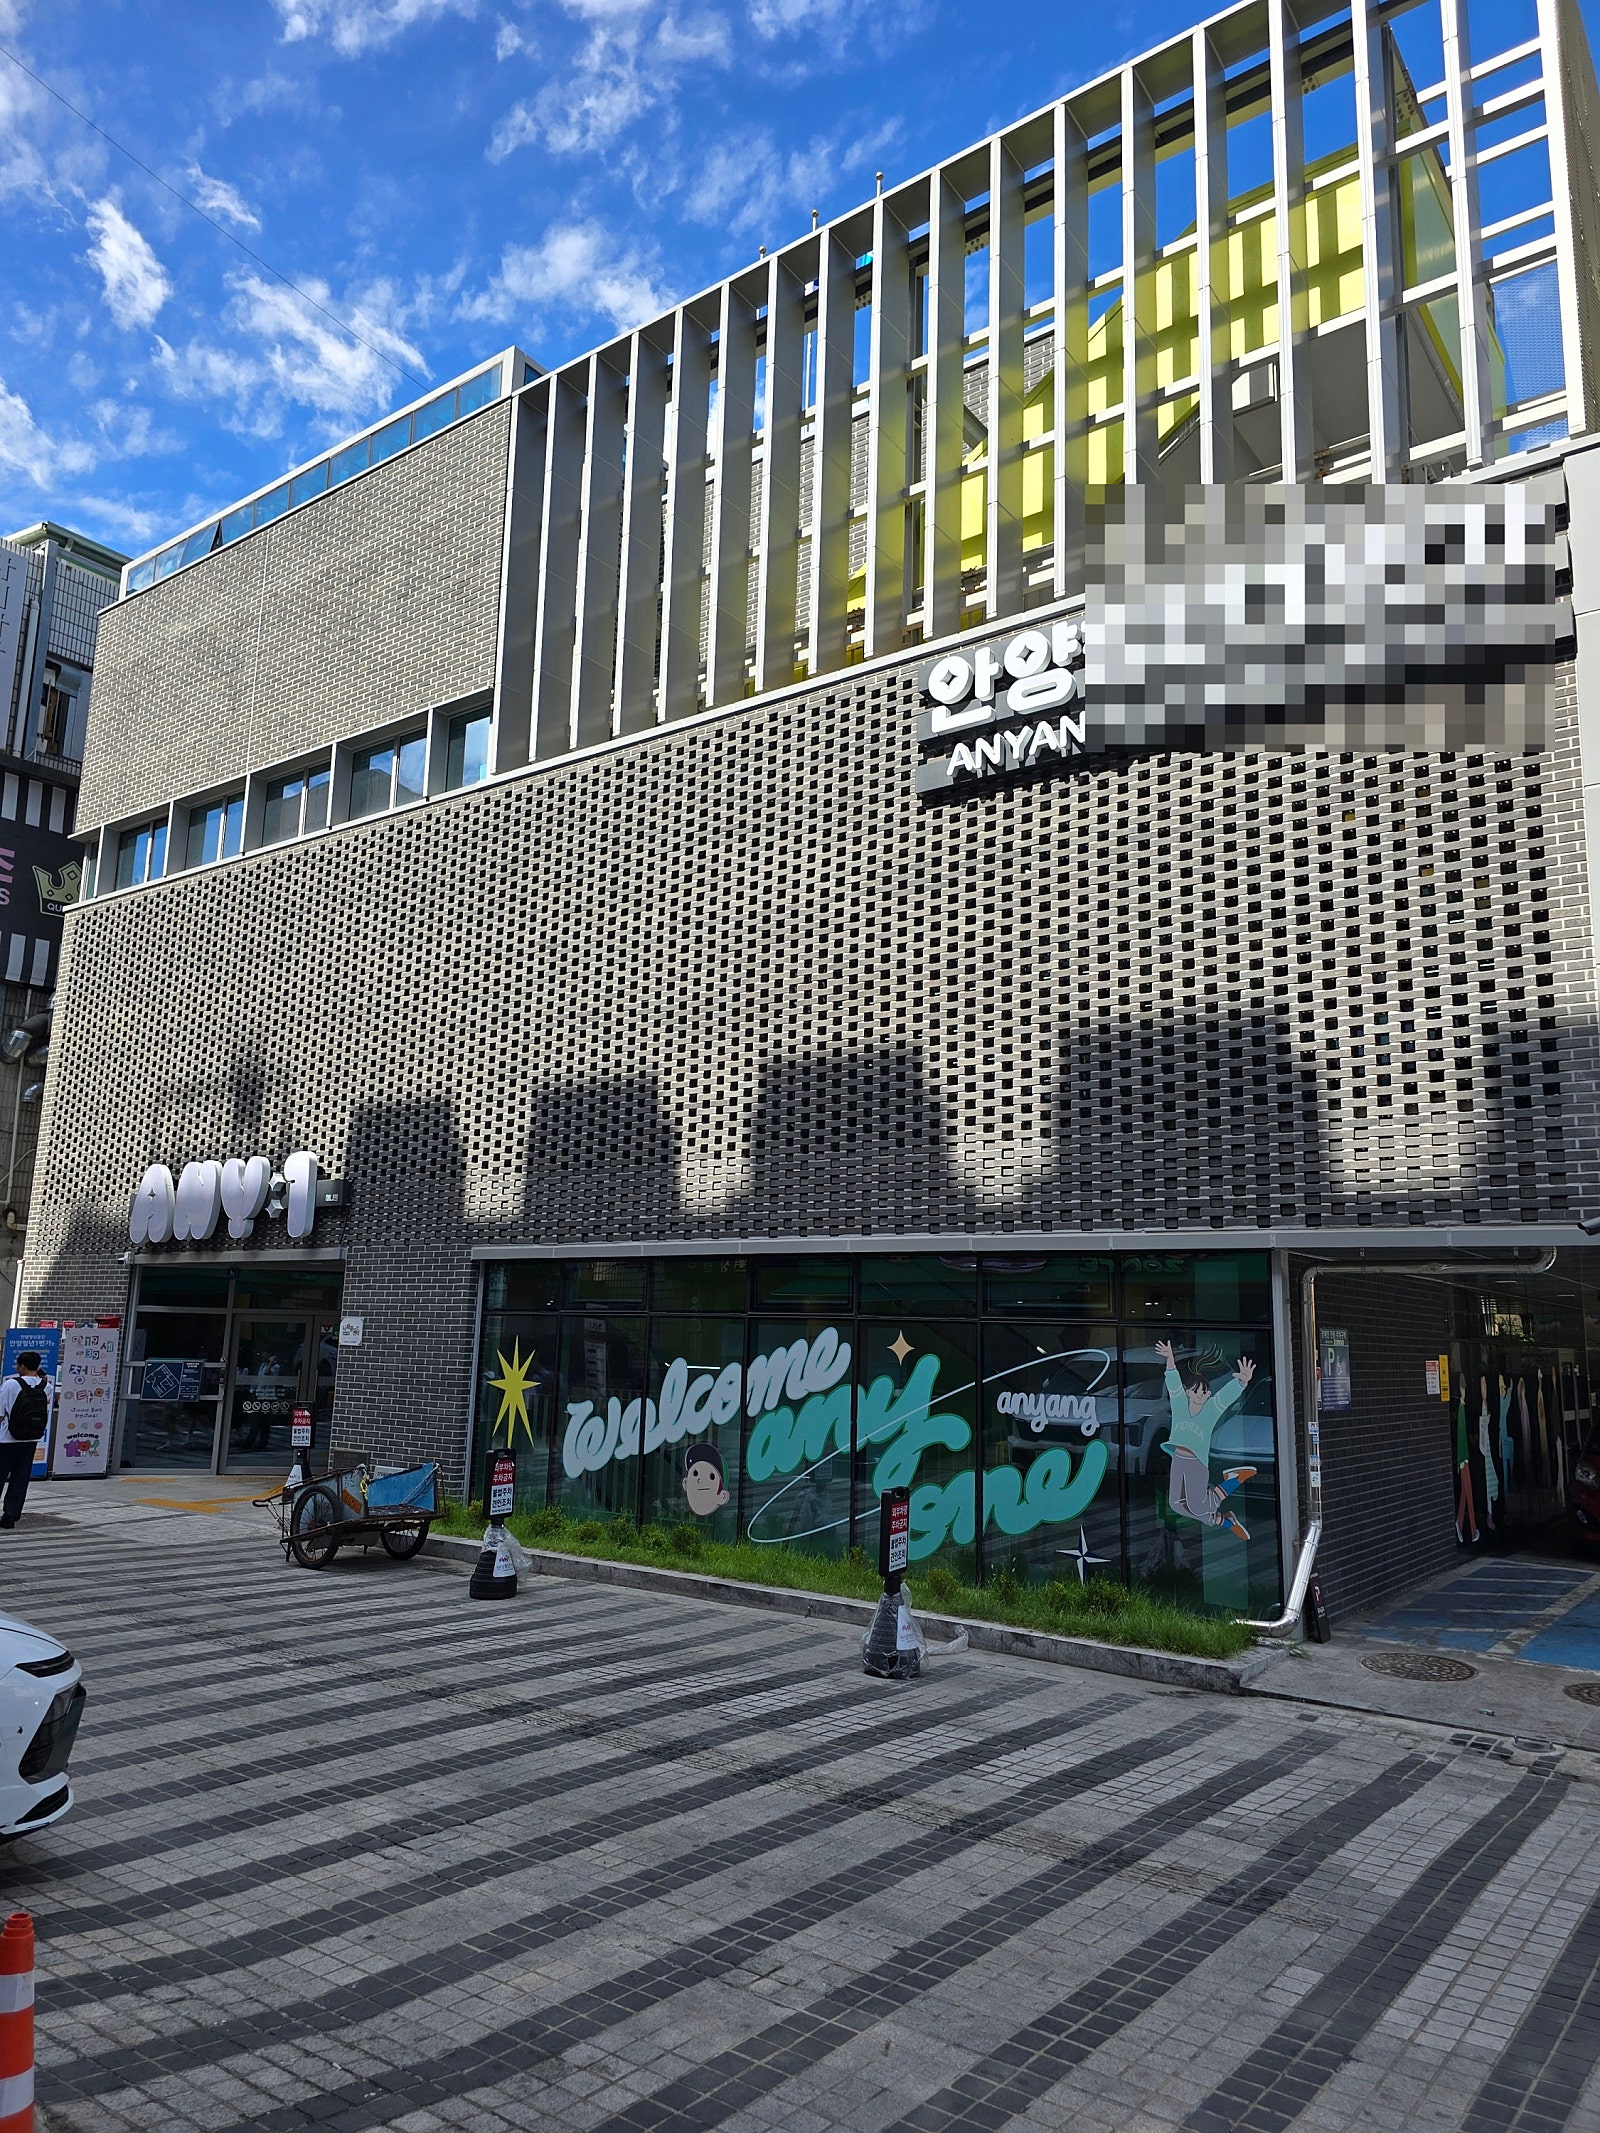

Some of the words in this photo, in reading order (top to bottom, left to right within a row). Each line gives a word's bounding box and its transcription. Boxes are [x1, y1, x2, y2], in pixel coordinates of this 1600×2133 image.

[946, 710, 1085, 776] ANYAN
[562, 1326, 852, 1479] Welcome
[997, 1389, 1100, 1437] anyang
[66, 1432, 100, 1440] welcome
[492, 1472, 513, 1483] 주차금지
[492, 1486, 512, 1498] 불법주차
